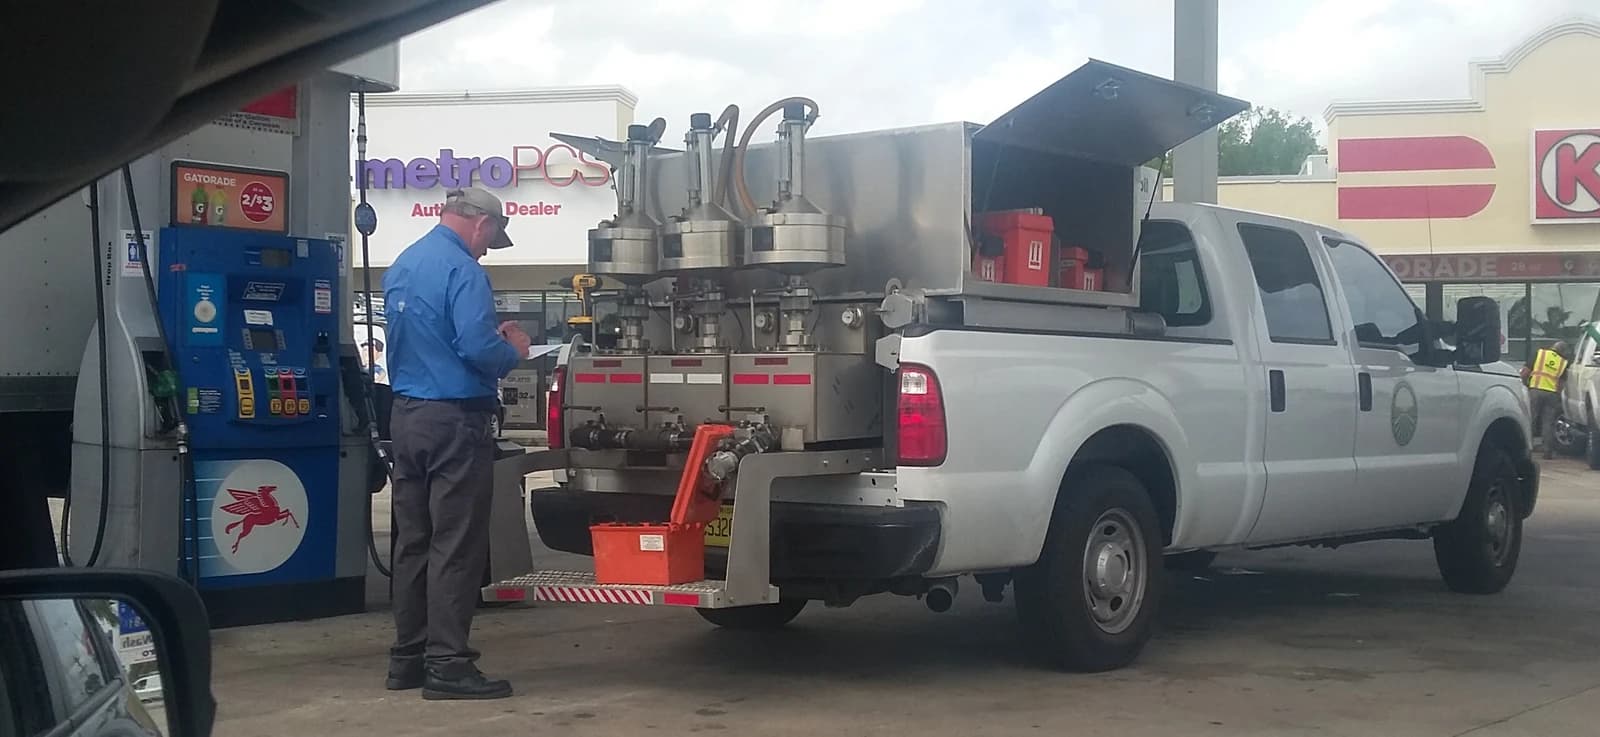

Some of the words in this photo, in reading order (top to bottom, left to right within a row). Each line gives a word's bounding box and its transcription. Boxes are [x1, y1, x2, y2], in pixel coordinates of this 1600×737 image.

[355, 144, 609, 189] metroPCS
[1555, 141, 1600, 206] K
[183, 172, 237, 187] GATORADE
[241, 193, 274, 212] 2/$3
[506, 201, 561, 216] Dealer
[1393, 256, 1497, 277] ORADE
